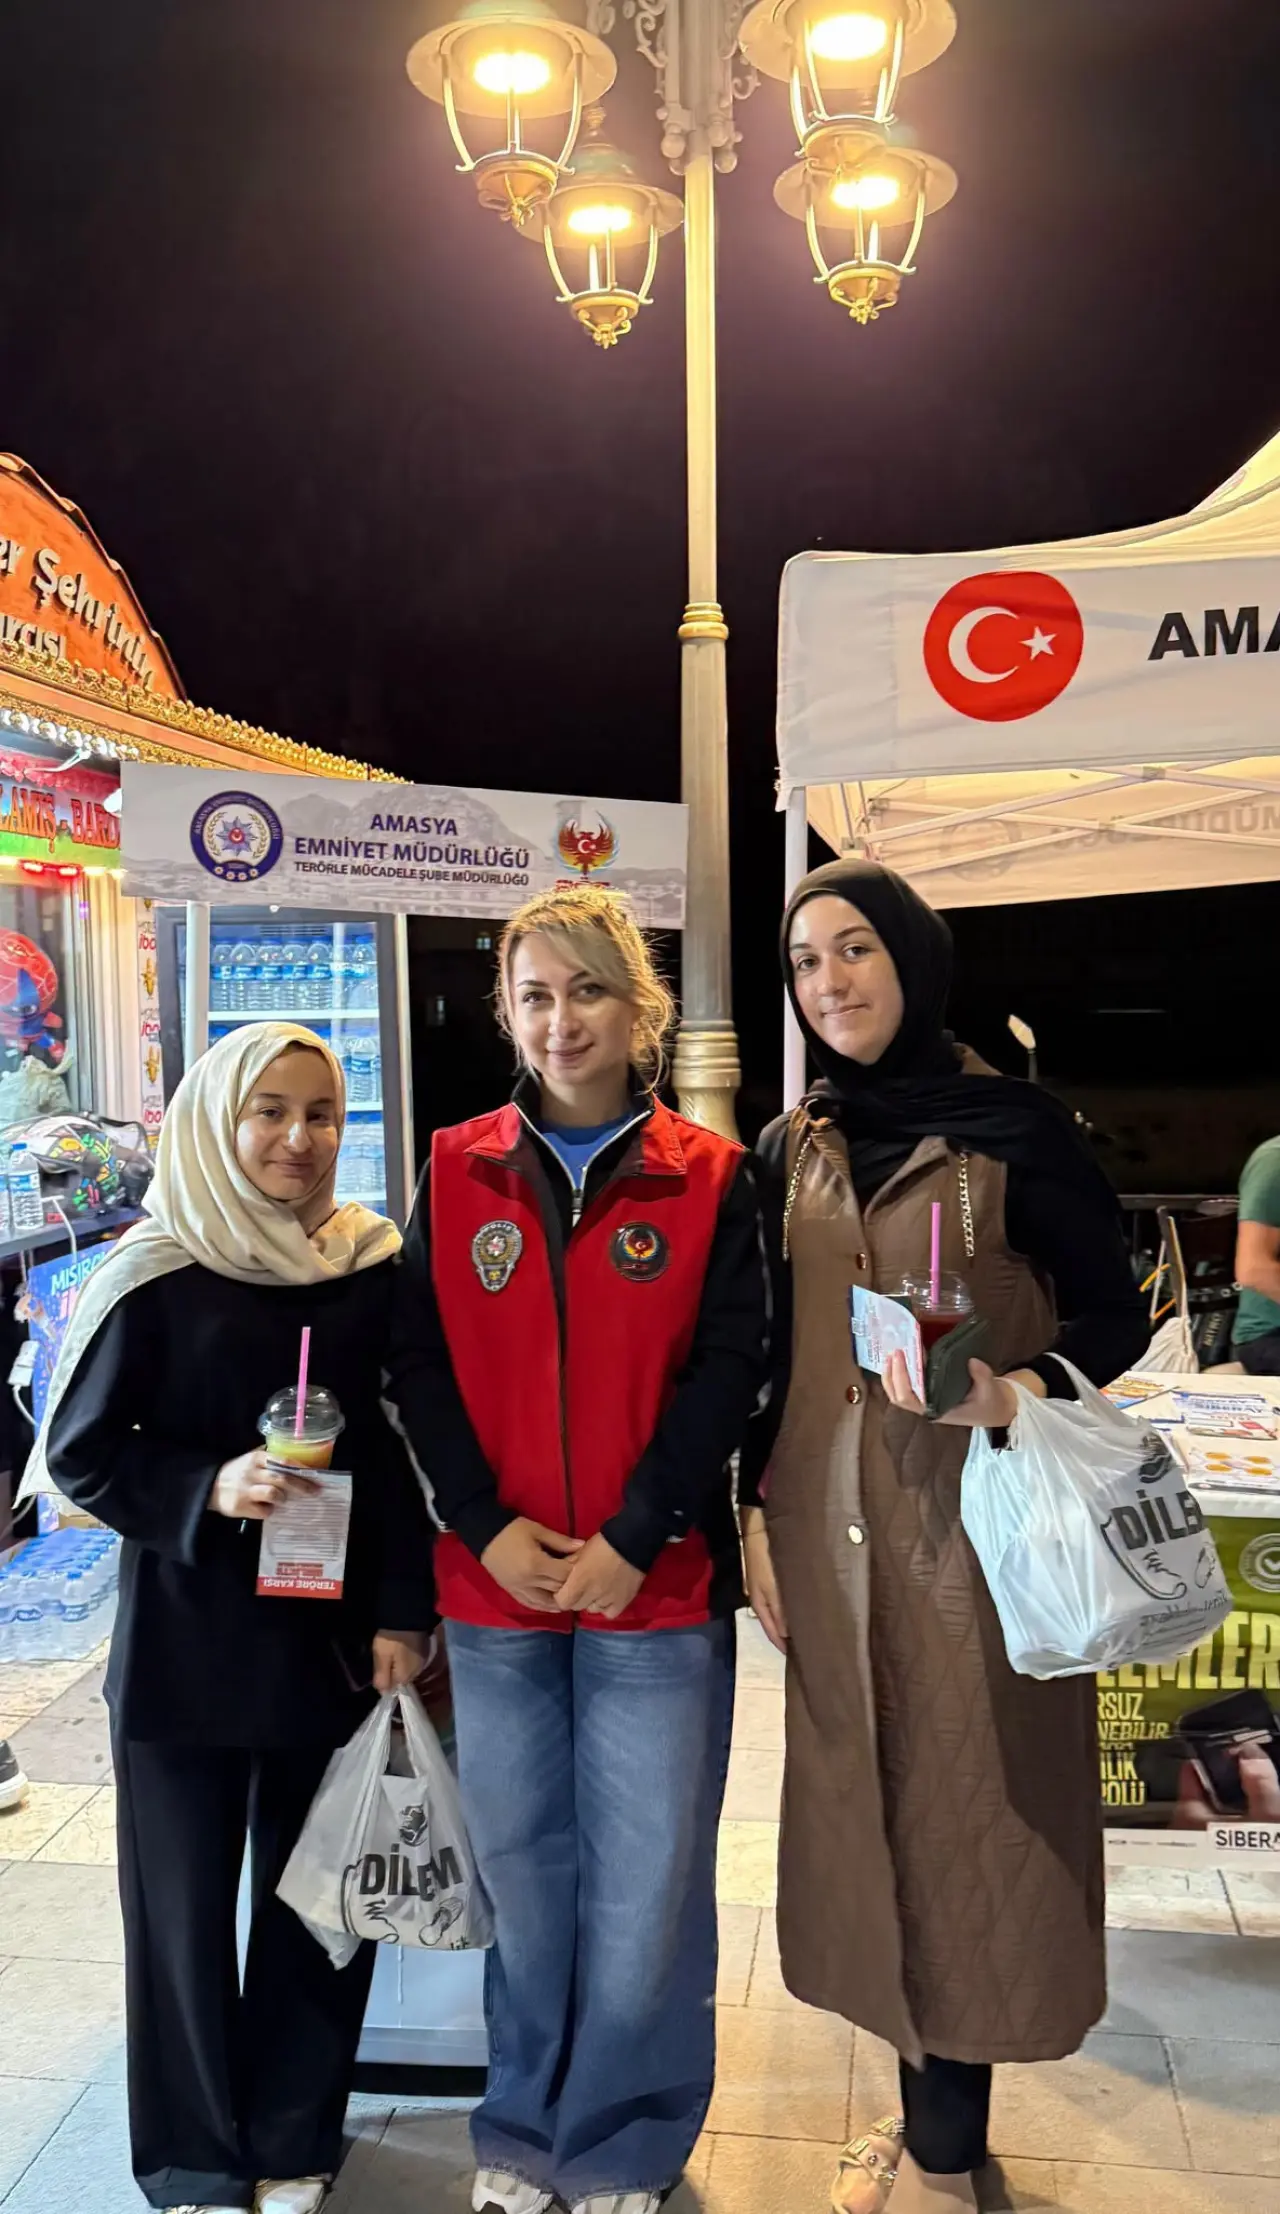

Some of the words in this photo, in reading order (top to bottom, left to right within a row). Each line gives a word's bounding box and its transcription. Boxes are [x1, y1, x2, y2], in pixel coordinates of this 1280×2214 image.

[370, 813, 459, 837] AMASYA
[294, 836, 389, 860] EMNİYET
[392, 840, 530, 869] MÜDÜRLÜĞÜ
[294, 861, 349, 875] TERÖRLE
[350, 862, 417, 879] MÜCADELE
[418, 869, 450, 882] ŞUBE
[451, 871, 530, 887] MÜDÜRLÜĞÜ
[359, 1843, 465, 1902] DİLEM
